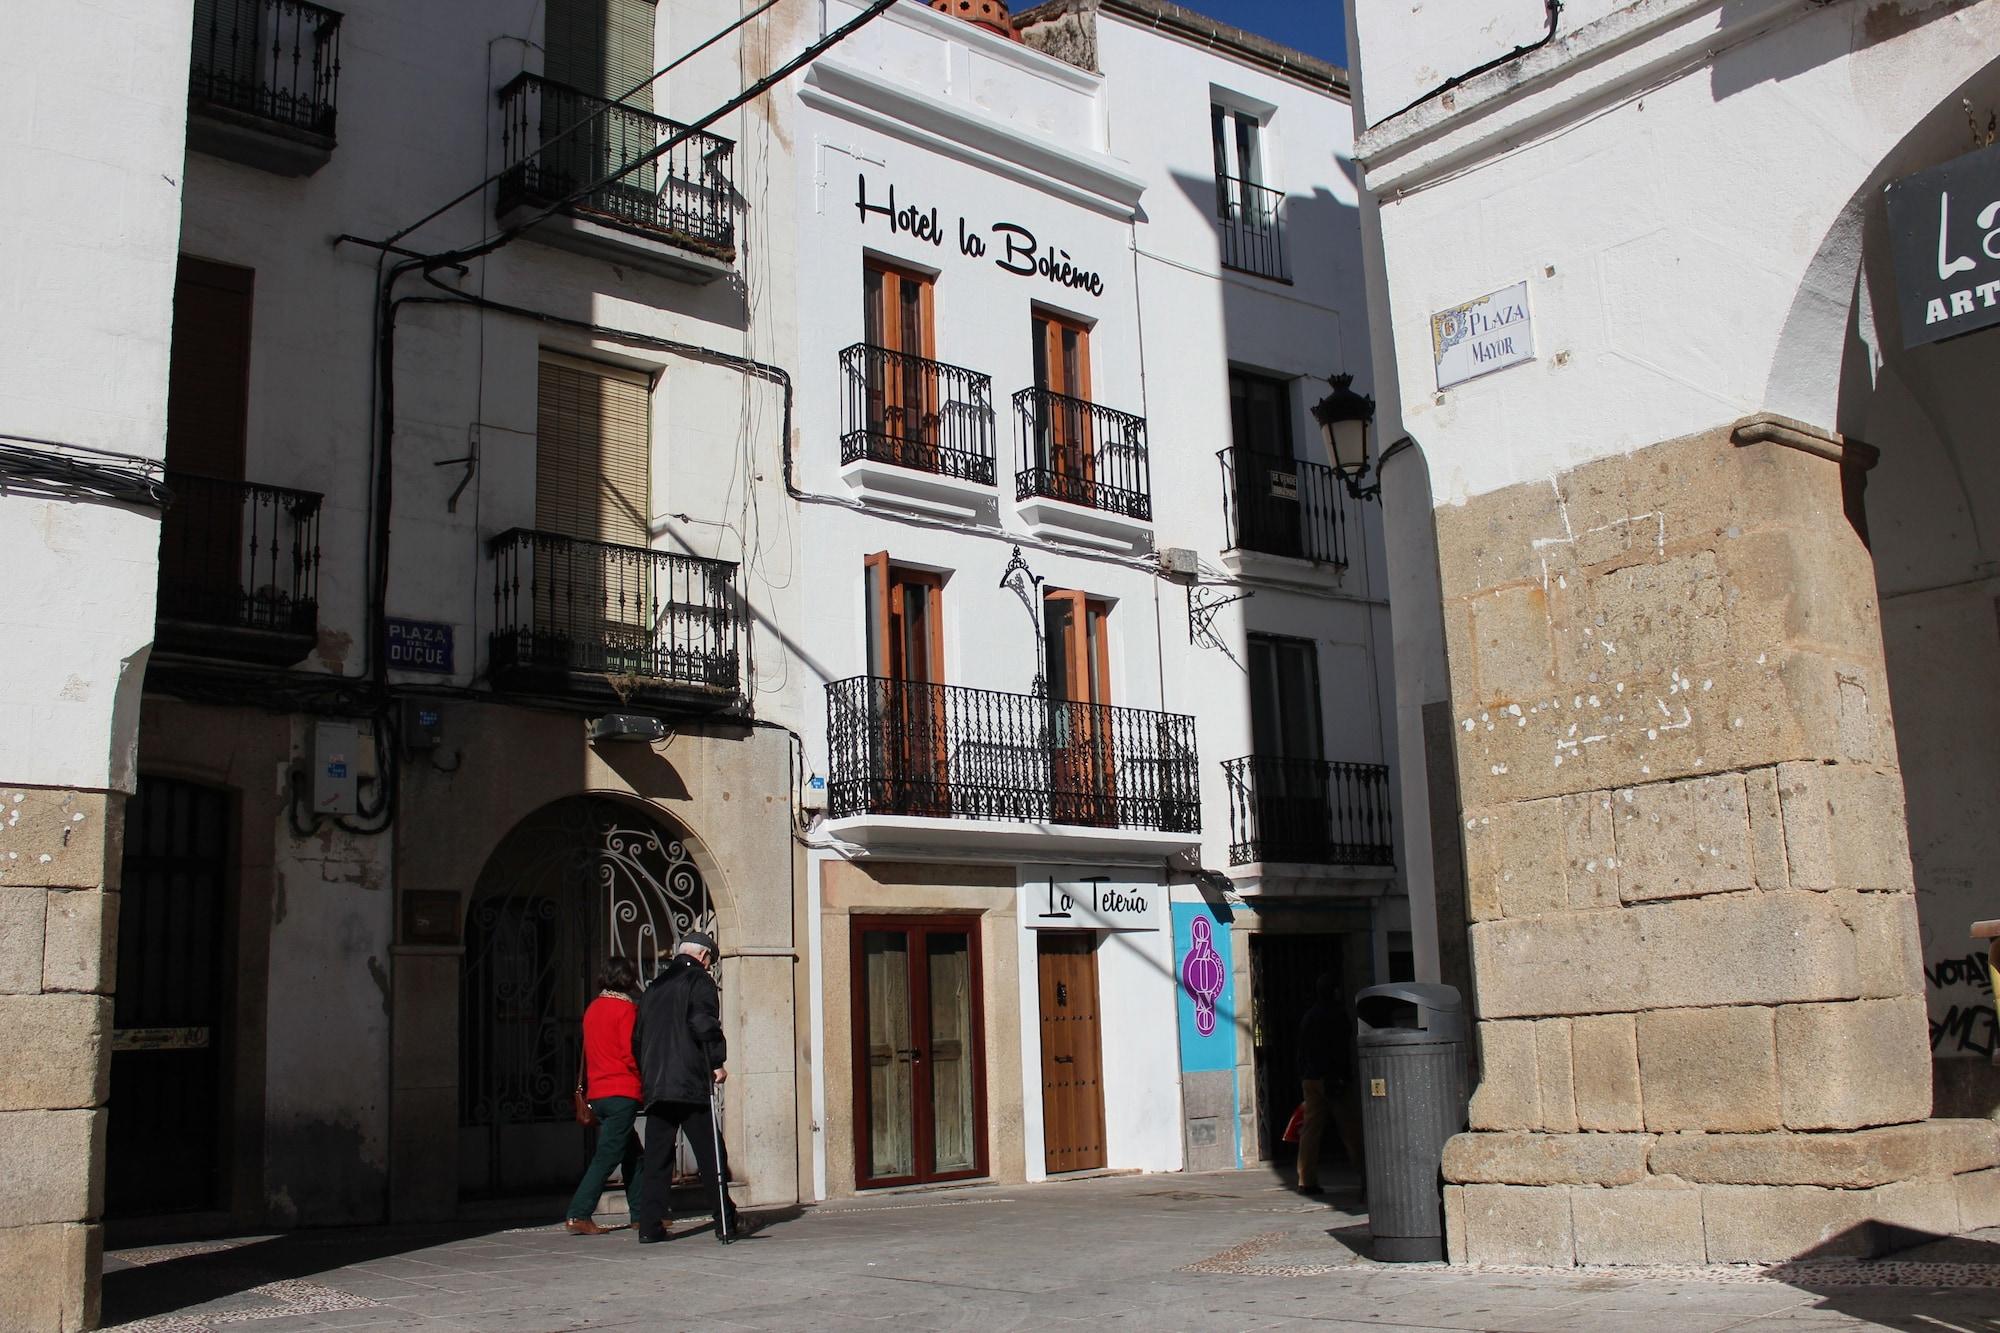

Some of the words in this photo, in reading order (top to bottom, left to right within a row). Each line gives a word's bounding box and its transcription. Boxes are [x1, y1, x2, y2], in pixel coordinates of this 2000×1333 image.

[855, 173, 943, 246] Hotel
[959, 217, 985, 257] la
[992, 222, 1104, 297] Bohème
[1469, 303, 1525, 336] PLAZA
[1471, 336, 1518, 364] MAYOR
[389, 624, 446, 643] PLAZA
[1038, 875, 1074, 918] La
[1080, 876, 1148, 914] Tetería
[1188, 920, 1220, 1031] OZONO
